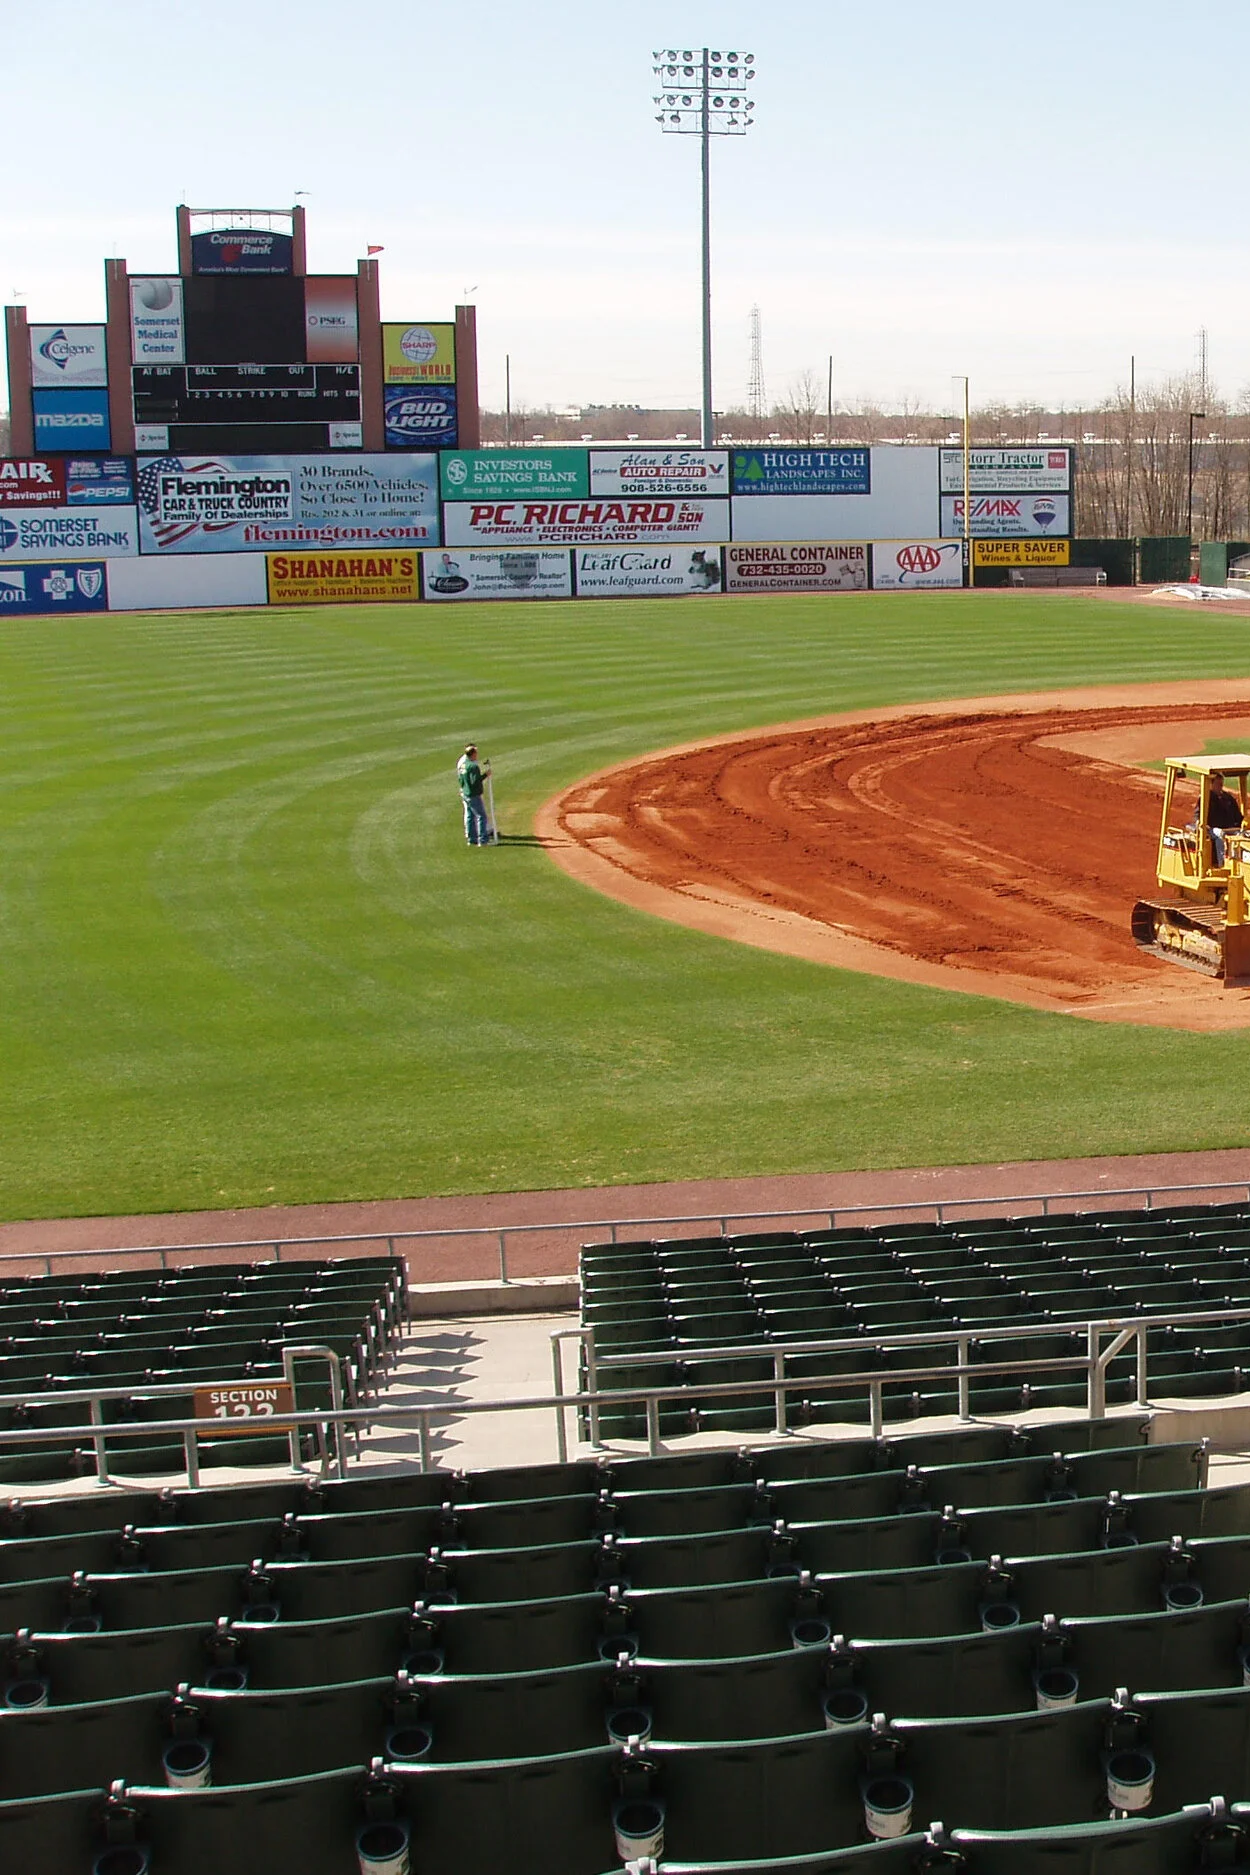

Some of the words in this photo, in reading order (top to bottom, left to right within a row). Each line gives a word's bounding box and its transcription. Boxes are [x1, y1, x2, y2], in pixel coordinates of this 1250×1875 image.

[210, 233, 274, 245] Commerce
[241, 244, 272, 255] Bank
[134, 316, 180, 326] Somerset
[138, 329, 178, 340] Medical
[51, 342, 95, 357] Celgene
[142, 343, 175, 354] Center
[402, 342, 437, 350] SHARP
[142, 367, 153, 376] AT
[156, 367, 172, 376] BAT
[195, 367, 217, 376] BALL
[237, 366, 266, 375] STRIKE
[288, 366, 305, 375] OUT
[335, 366, 354, 375] H/E
[297, 390, 317, 398] RUNS
[323, 390, 339, 398] HITS
[399, 402, 447, 415] BUD
[35, 413, 105, 427] mazda
[387, 415, 453, 428] LIGHT
[620, 453, 657, 466] Alan
[662, 453, 673, 466] &
[677, 453, 706, 466] Son
[762, 453, 812, 467] HIGH
[815, 452, 865, 467] TECH
[999, 451, 1045, 464] Tractor
[299, 465, 317, 478] 30
[474, 460, 553, 471] INVESTORS
[474, 472, 533, 483] SAVINGS
[538, 472, 578, 483] BANK
[624, 467, 656, 477] AUTO
[659, 467, 703, 477] REPAIR
[766, 469, 836, 479] LANDSCAPES
[841, 469, 864, 479] INC.
[161, 476, 291, 497] Flemington
[300, 481, 333, 492] Over
[335, 479, 369, 491] 6500
[620, 483, 708, 493] 908-526-6556
[737, 481, 866, 492] www.hightechlandscapes.com
[6, 490, 61, 501] Savings!!!
[84, 486, 130, 498] PEPSI
[300, 492, 318, 505] So
[321, 492, 357, 504] Close
[362, 492, 377, 504] To
[381, 491, 425, 503] Home!
[163, 498, 186, 511] CAR
[188, 498, 197, 510] &
[199, 498, 235, 510] TRUCK
[238, 495, 290, 509] COUNTRY
[953, 498, 1022, 517] RE/MAX
[164, 511, 202, 522] Family
[204, 510, 219, 520] Of
[221, 509, 289, 520] Dealerships
[322, 509, 340, 518] 202
[341, 509, 350, 518] &
[366, 510, 377, 518] or
[379, 508, 407, 518] online
[468, 504, 517, 526] P.C.
[522, 502, 676, 525] RICHARD
[680, 502, 691, 512] &
[677, 512, 704, 523] SON
[19, 518, 99, 534] SOMERSET
[481, 526, 534, 534] APPLIANCE
[542, 524, 603, 533] ELECTRONICS
[612, 524, 664, 532] COMPUTER
[666, 523, 700, 531] GIANT!
[243, 524, 429, 543] flemington.com
[20, 533, 85, 549] SAVINGS
[88, 532, 129, 547] BANK
[977, 542, 1020, 553] SUPER
[1023, 542, 1066, 553] SAVER
[469, 553, 504, 563] Bringing
[541, 552, 565, 560] Home
[729, 547, 787, 562] GENERAL
[790, 546, 864, 561] CONTAINER
[901, 545, 937, 572] AAA
[980, 554, 1012, 562] Wines
[1015, 554, 1022, 562] &
[1025, 554, 1057, 563] Liquor
[273, 556, 413, 579] SHANAHAN'S
[741, 564, 823, 576] 732-435-0020
[580, 575, 684, 589] www.leafguard.com
[276, 584, 412, 597] www.shanahans.net
[210, 1389, 278, 1404] SECTION
